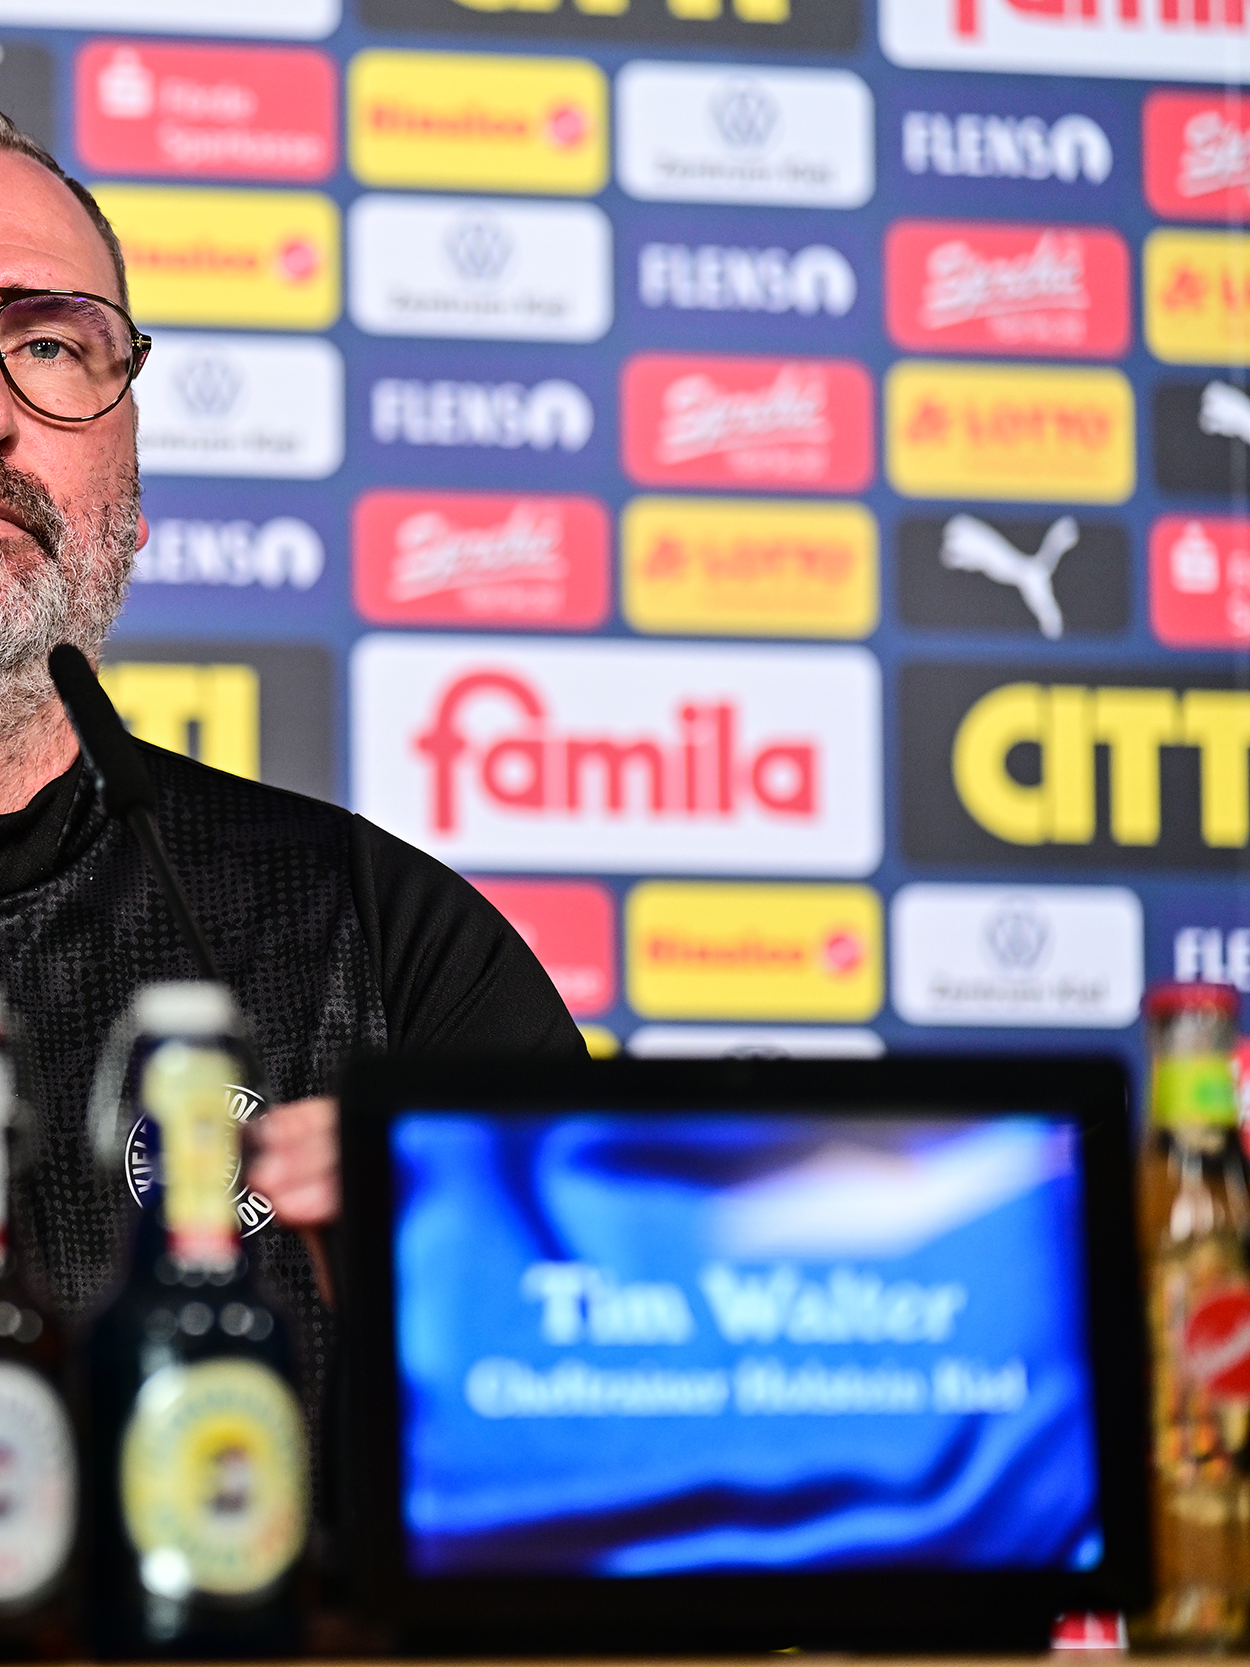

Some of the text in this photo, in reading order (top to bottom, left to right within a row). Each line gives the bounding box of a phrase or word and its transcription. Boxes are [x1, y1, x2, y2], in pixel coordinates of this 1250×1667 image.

[412, 665, 820, 837] famila
[951, 682, 1250, 848] CITT
[523, 1262, 965, 1346] Tim Walter
